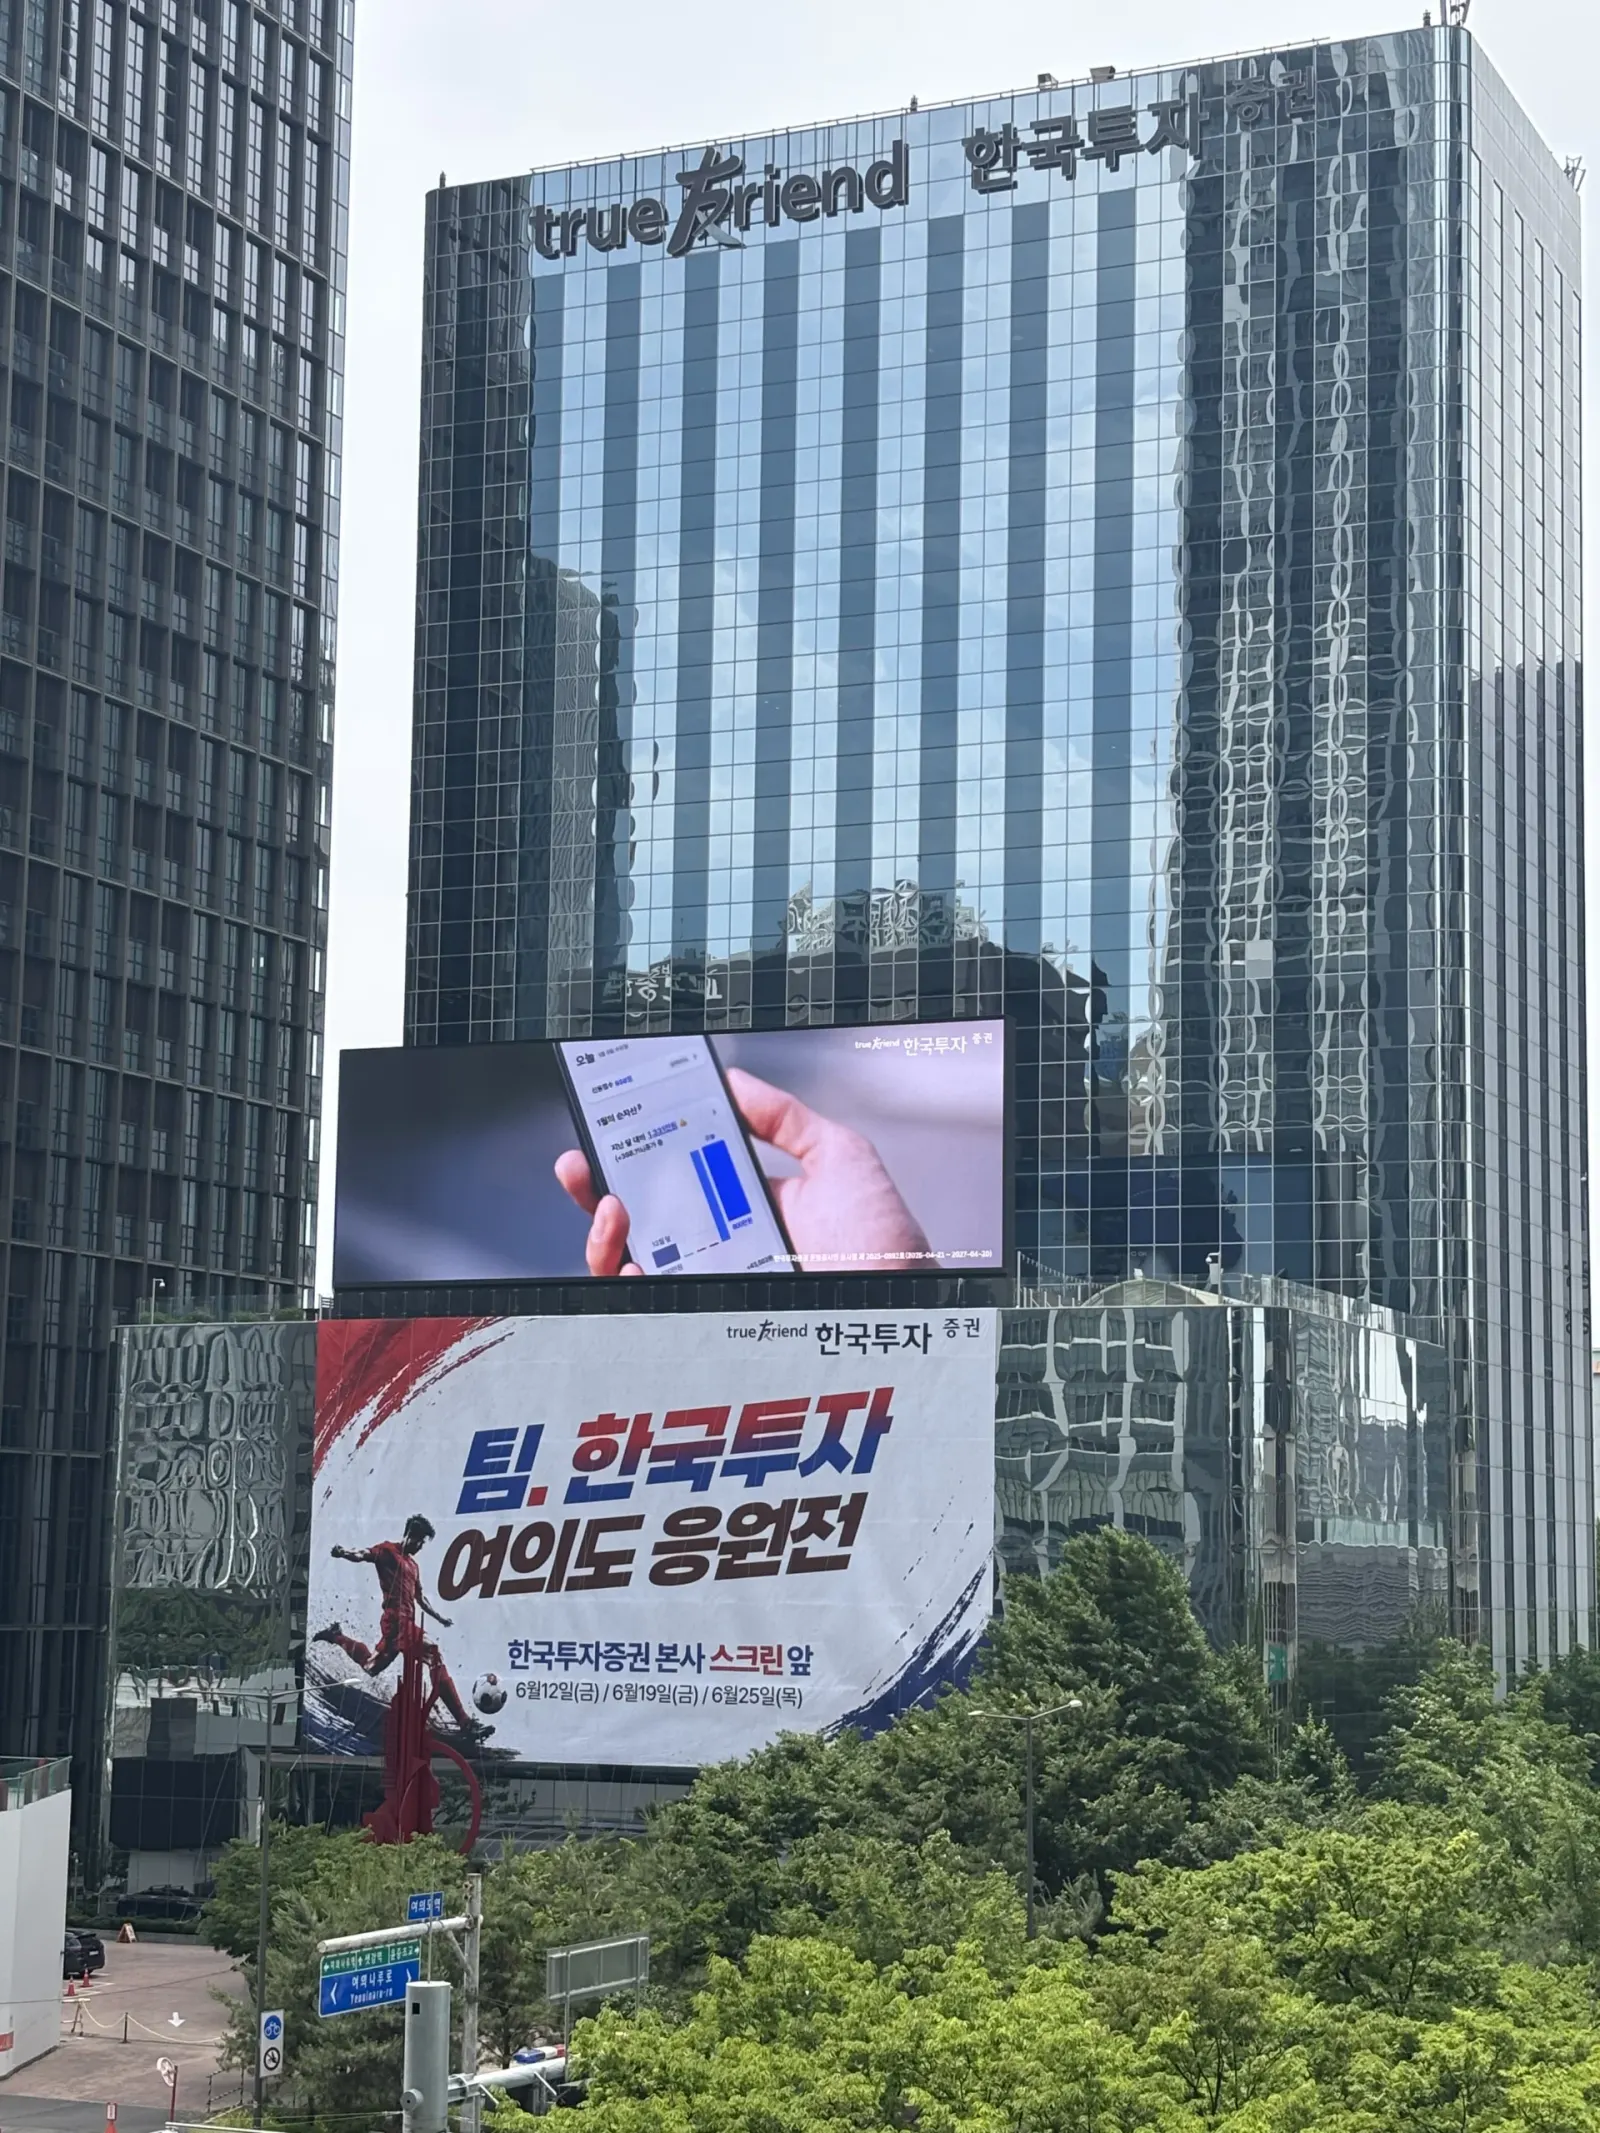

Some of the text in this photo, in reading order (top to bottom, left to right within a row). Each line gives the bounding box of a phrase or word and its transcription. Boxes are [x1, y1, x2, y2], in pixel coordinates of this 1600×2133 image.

[961, 90, 1206, 193] 한국투자
[1226, 66, 1315, 122] 증권
[576, 1053, 596, 1066] 오늘
[904, 1036, 967, 1056] 한국투자
[972, 1032, 993, 1045] 증권
[815, 1322, 932, 1355] 한국투자
[942, 1318, 980, 1338] 증권
[456, 1387, 894, 1514] 팀. 한국투자
[437, 1492, 867, 1600] 여의도 응원전
[507, 1639, 814, 1676] 한국투자증권 본사 스크린 앞
[516, 1681, 599, 1703] 6월12일(금)
[613, 1683, 699, 1706] 6월19일(금)
[711, 1685, 803, 1709] 6월25일(목)
[352, 1969, 393, 1990] 여의나루로
